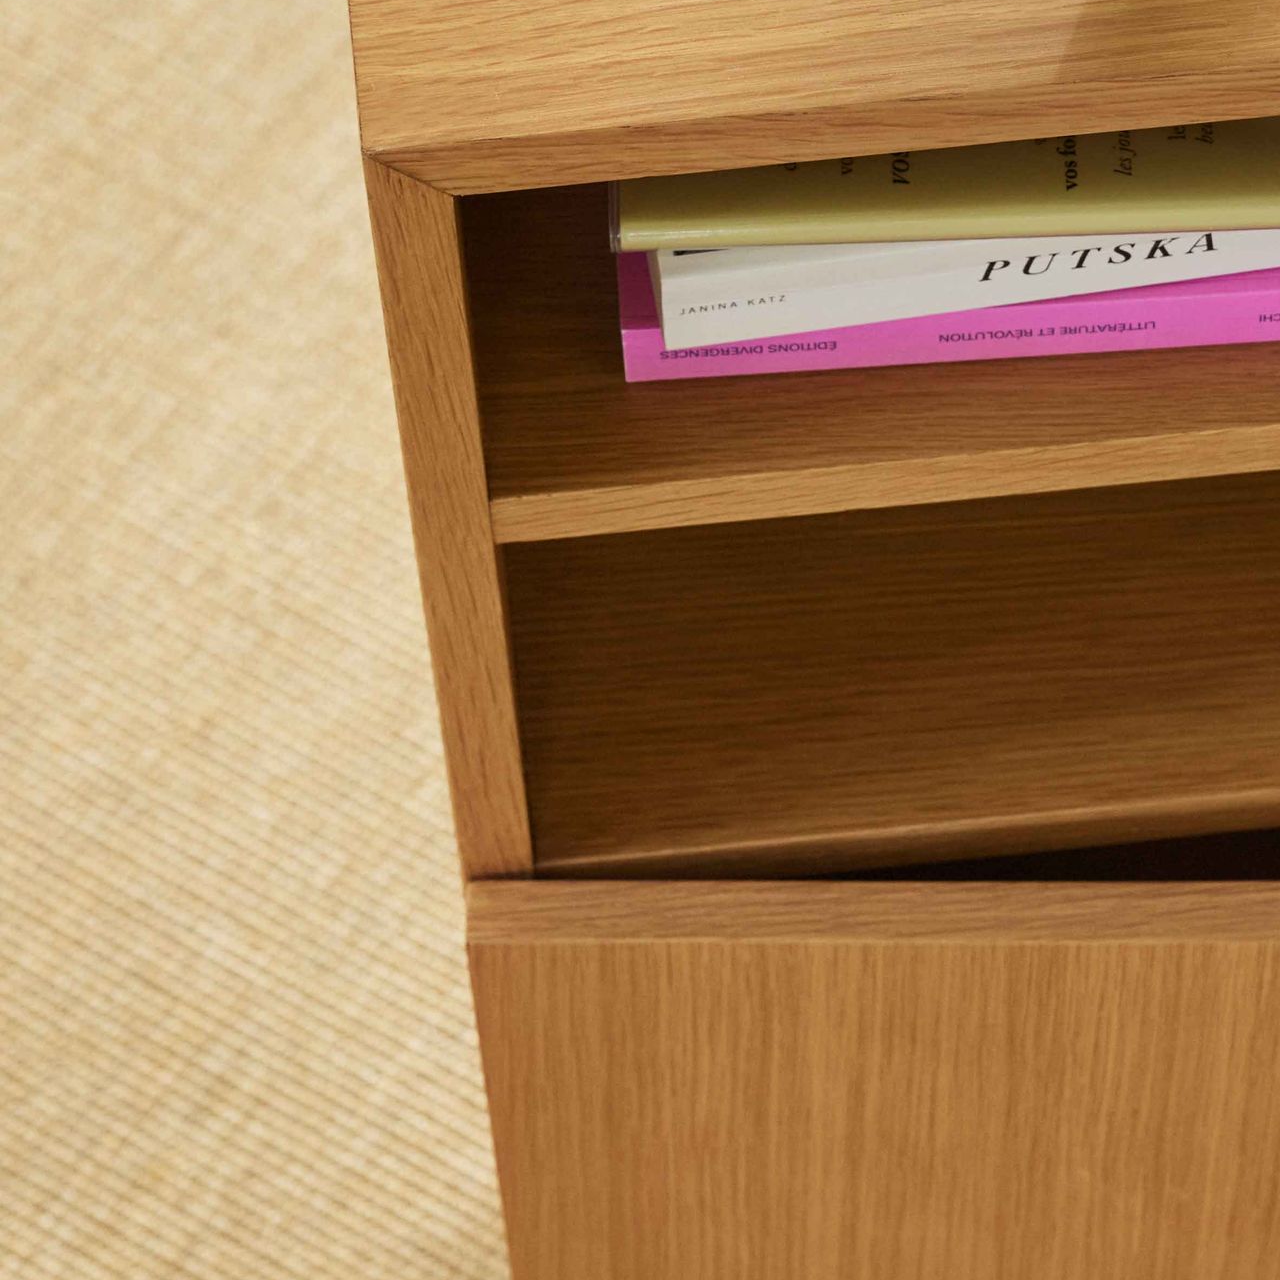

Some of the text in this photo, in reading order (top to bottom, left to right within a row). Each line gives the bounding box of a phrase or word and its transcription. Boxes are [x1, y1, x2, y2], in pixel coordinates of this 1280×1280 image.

[1065, 160, 1078, 191] vos
[1113, 155, 1133, 176] les
[978, 232, 1218, 282] PUTSKA
[680, 294, 786, 316] JANINA KATZ
[938, 320, 1157, 343] LITTÉRATURE ET RÉVOLUTION
[659, 340, 838, 360] ÉDITIONS DIVERGENCES
